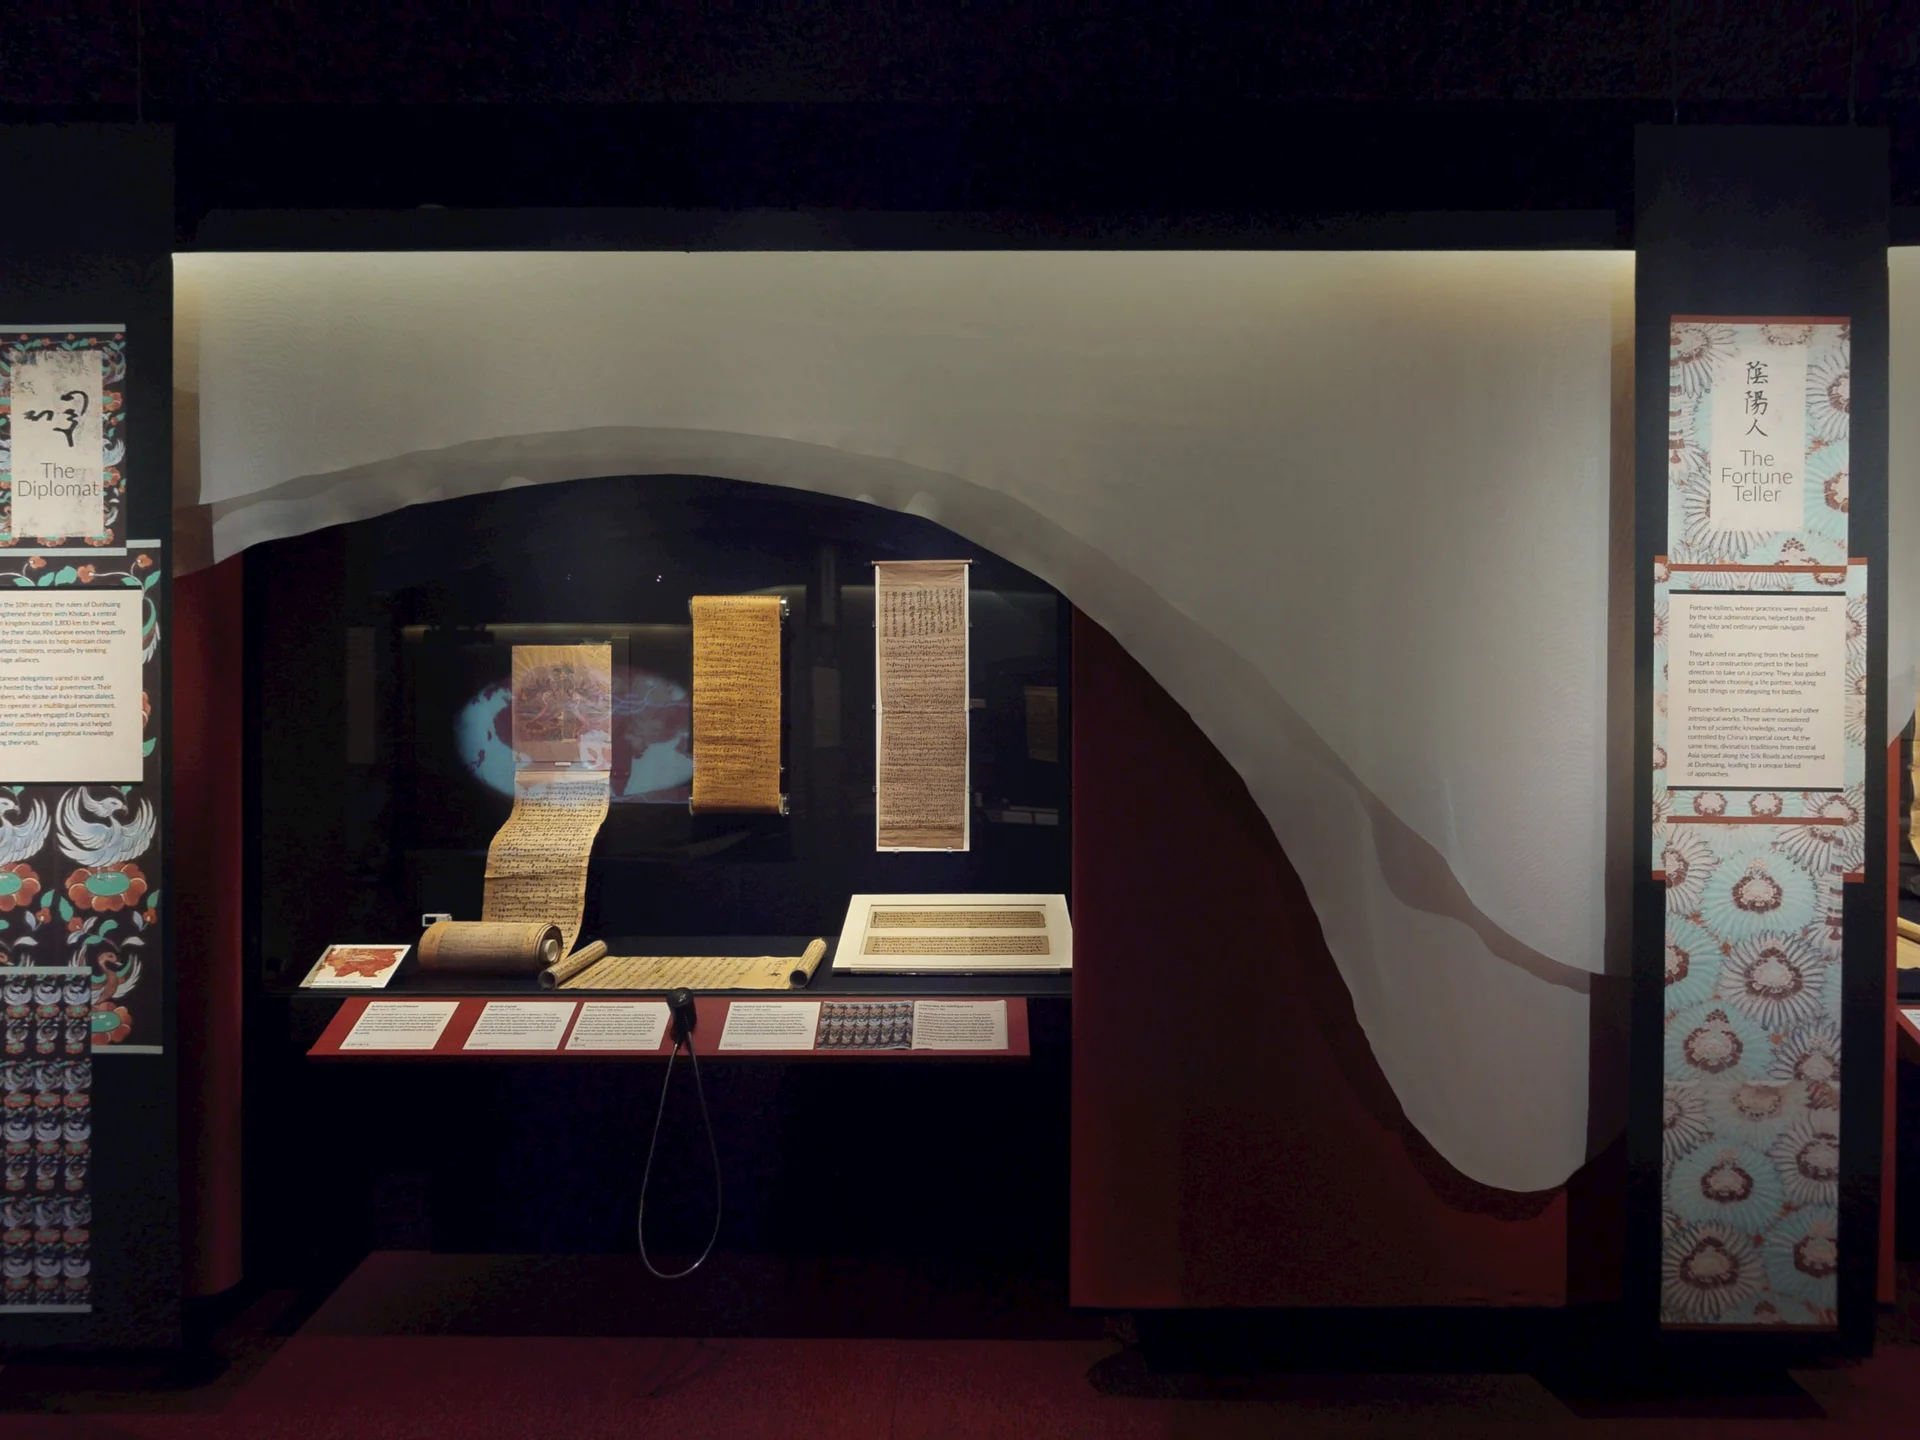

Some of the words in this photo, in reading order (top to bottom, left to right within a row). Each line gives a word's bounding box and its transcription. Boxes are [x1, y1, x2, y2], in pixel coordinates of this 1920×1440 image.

[1739, 449, 1774, 466] The
[40, 462, 75, 479] The
[1721, 467, 1793, 484] Fortune
[17, 480, 100, 500] Diplomat
[1732, 485, 1782, 502] Teller
